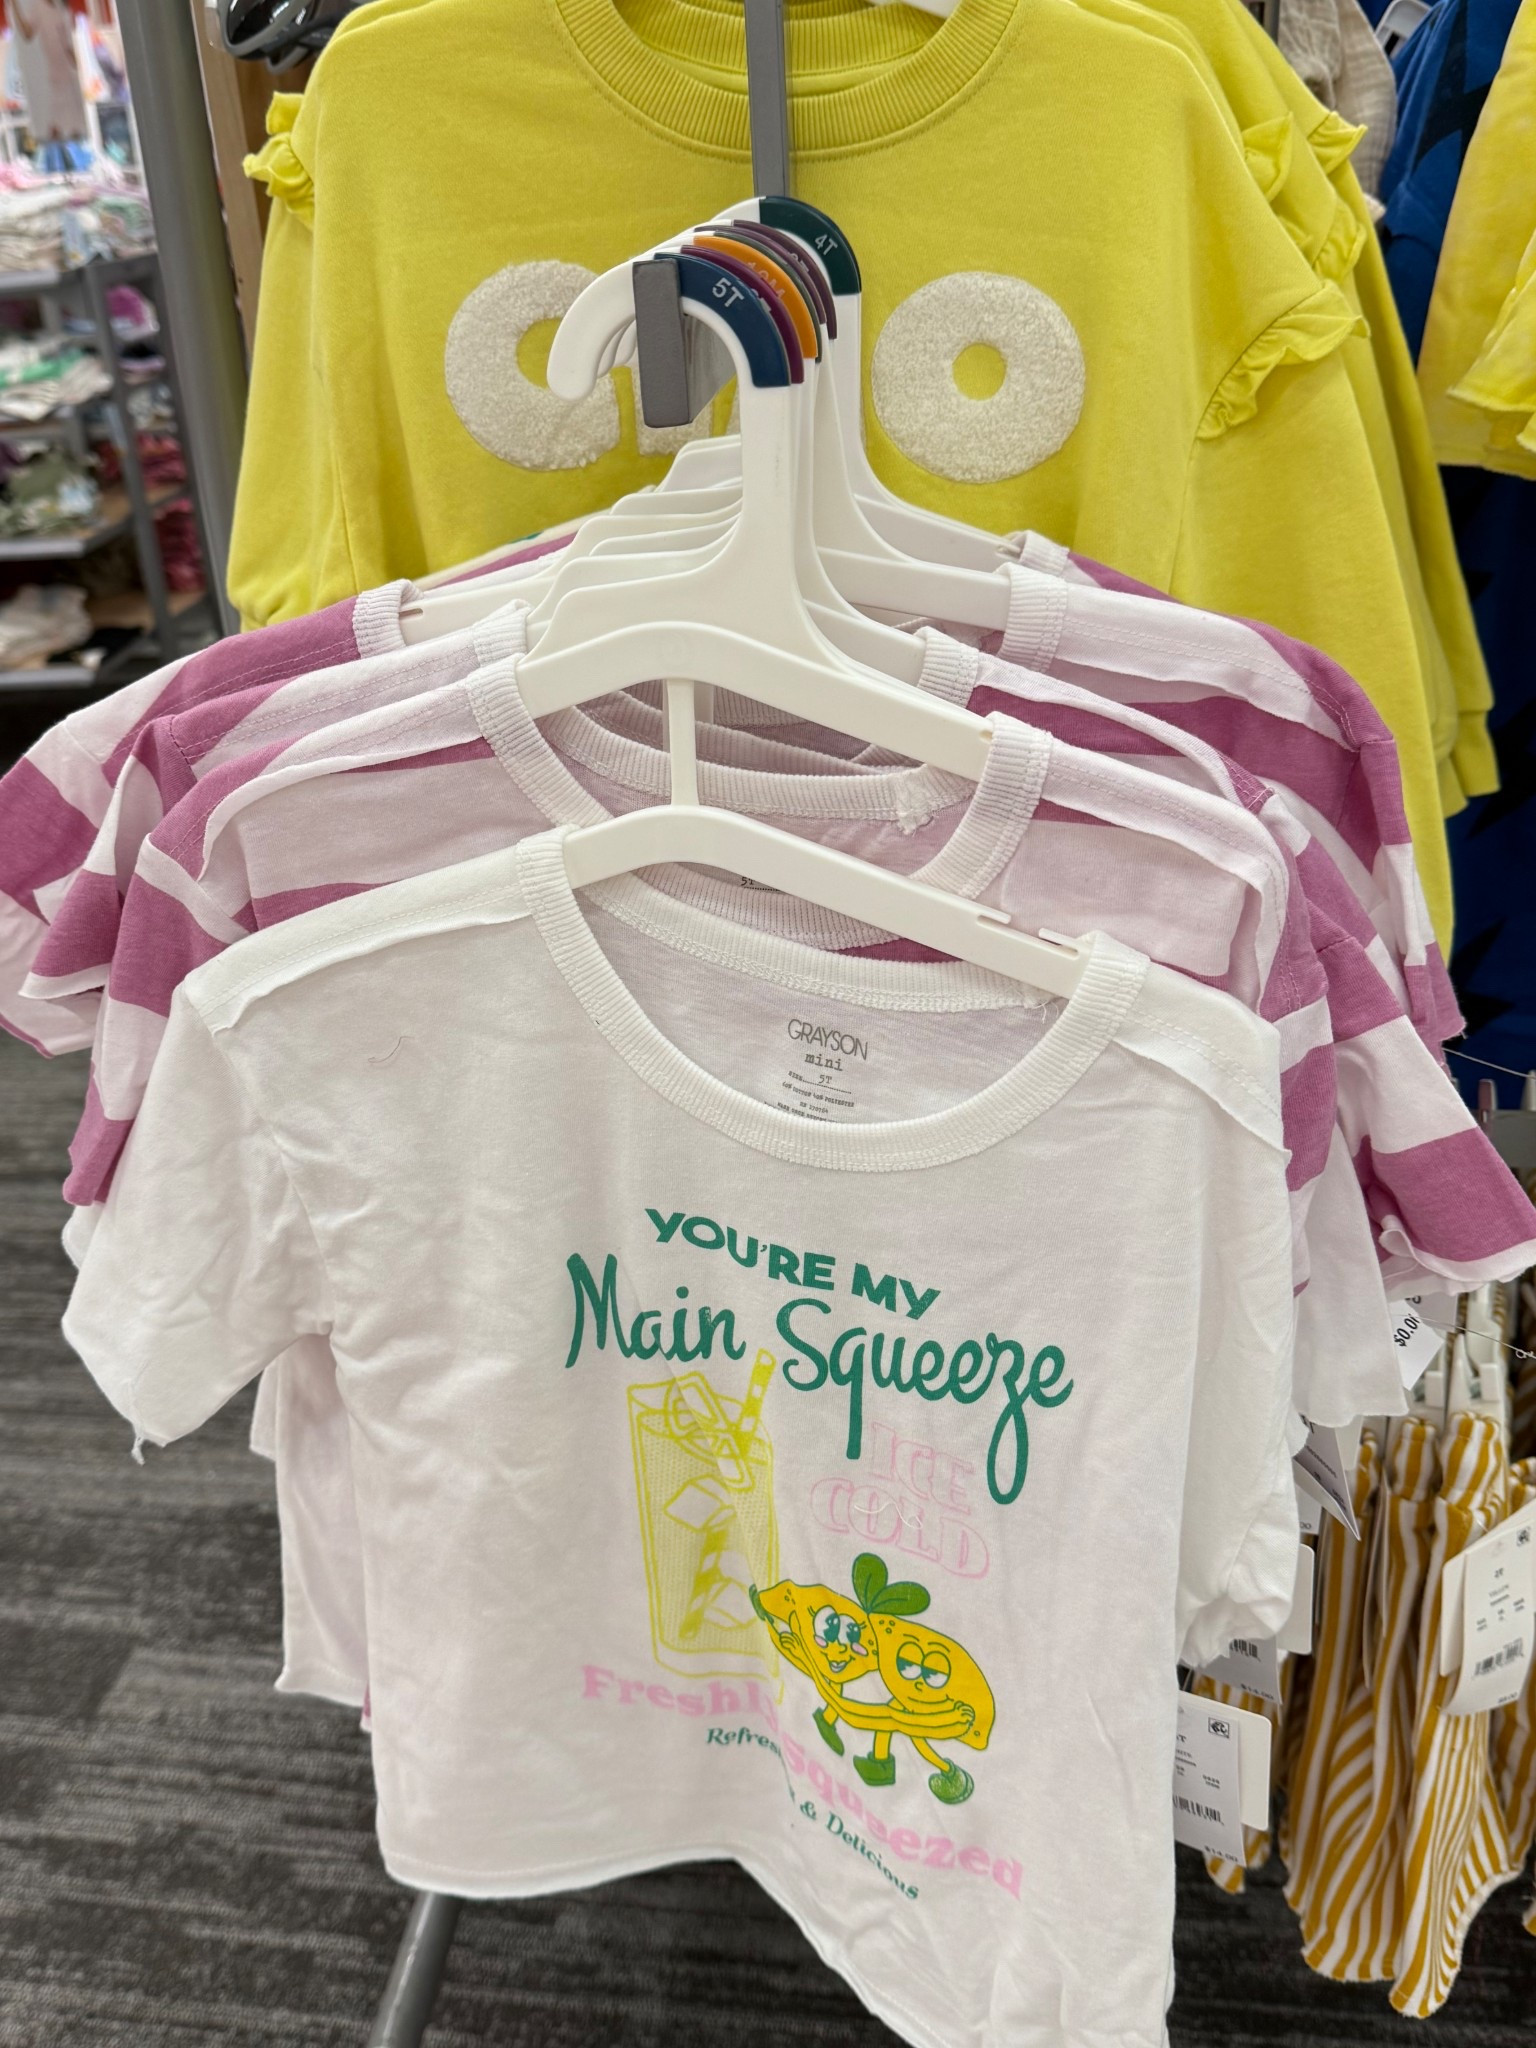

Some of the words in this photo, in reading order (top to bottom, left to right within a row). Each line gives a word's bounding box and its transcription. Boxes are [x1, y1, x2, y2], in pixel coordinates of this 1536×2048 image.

[815, 234, 837, 256] 4T
[712, 277, 744, 307] 5T
[788, 1018, 868, 1060] GRAYSON
[804, 1053, 843, 1071] mini
[818, 1074, 832, 1084] 5T
[645, 1208, 836, 1290] YOU'RE
[852, 1262, 941, 1320] MY
[565, 1253, 746, 1369] Main
[776, 1298, 1074, 1505] Squeeze
[868, 1421, 976, 1516] ICE
[810, 1477, 990, 1580] COLD
[800, 1801, 817, 1820] &
[826, 1811, 919, 1899] Delicious
